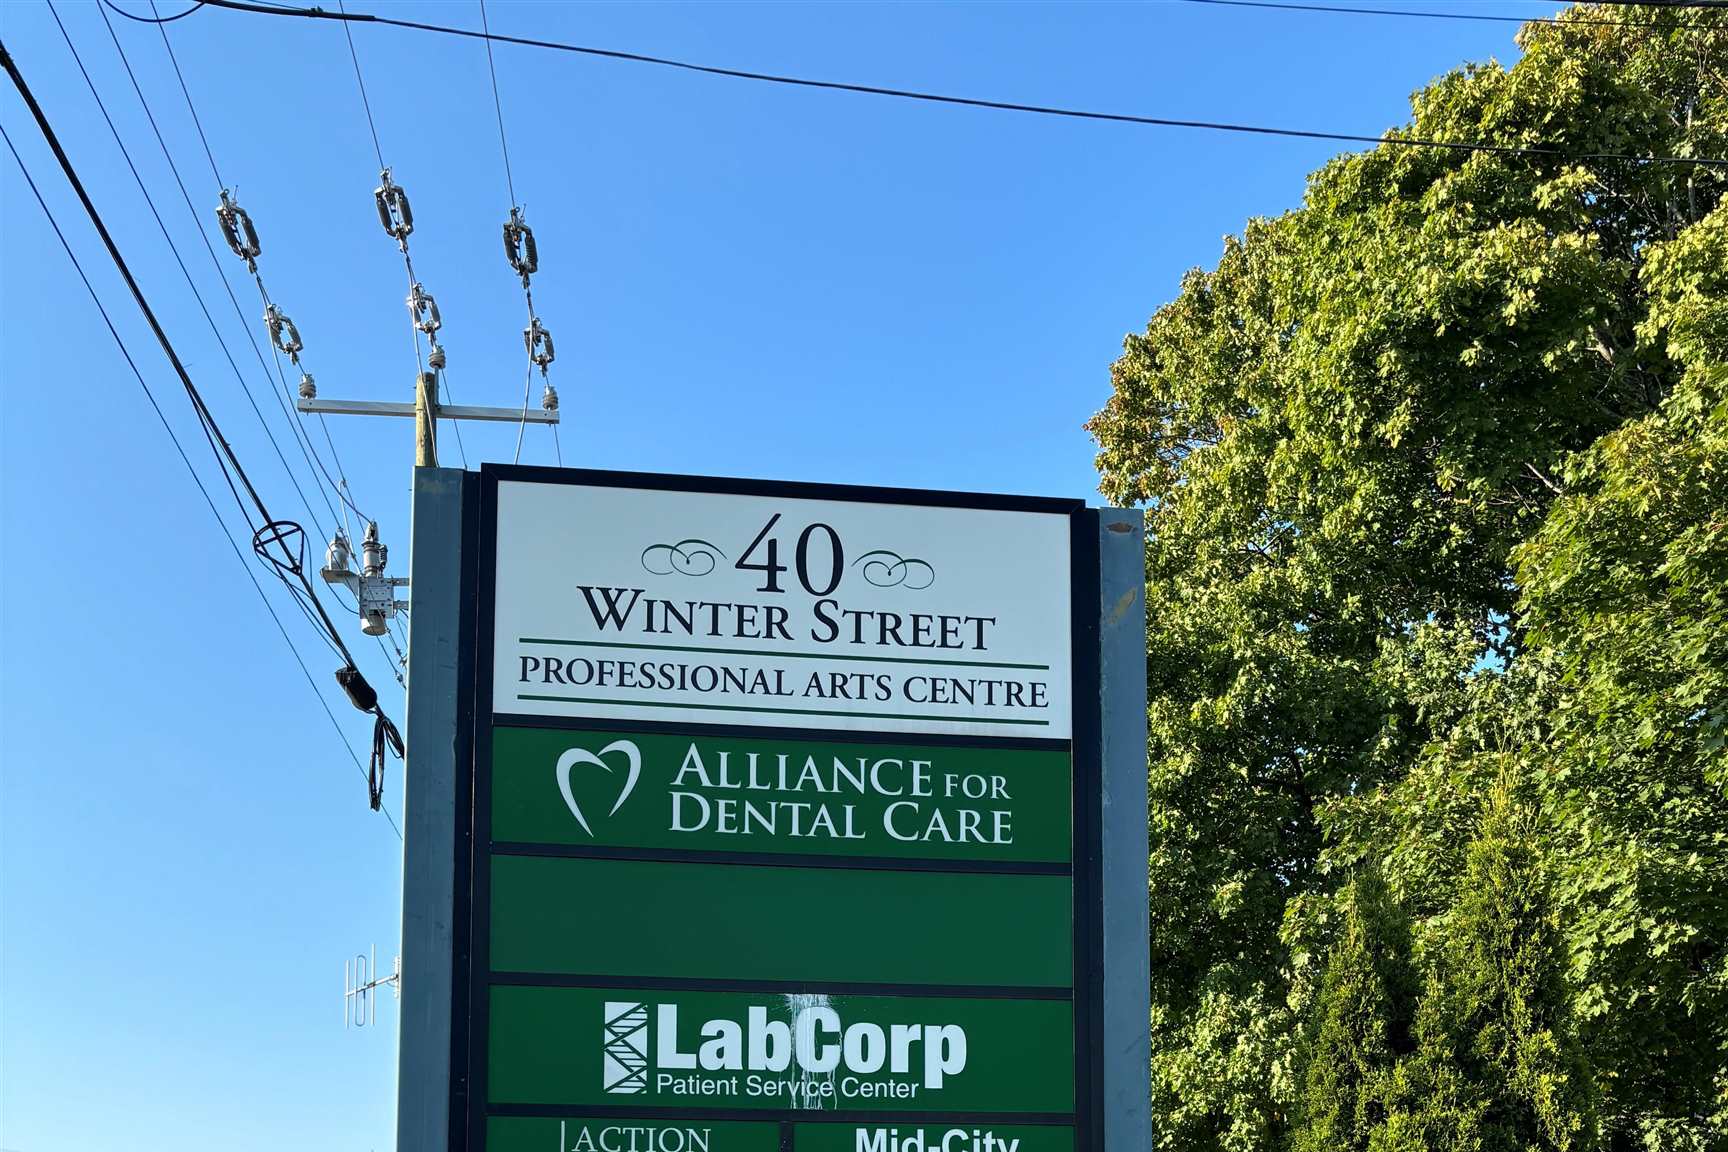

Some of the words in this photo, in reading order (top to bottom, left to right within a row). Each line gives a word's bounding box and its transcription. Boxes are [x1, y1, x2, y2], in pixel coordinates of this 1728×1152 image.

[735, 513, 844, 597] 40
[577, 585, 795, 641] WINTER
[811, 598, 996, 651] STREET
[518, 655, 795, 698] PROFESSIONAL
[802, 671, 892, 702] ARTS
[903, 676, 1050, 708] CENTRE
[669, 742, 933, 797] ALLIANCE
[944, 773, 1013, 800] FOR
[668, 791, 866, 839] DENTAL
[883, 801, 1013, 844] CARE
[656, 1003, 967, 1089] LabCorp
[657, 1073, 739, 1096] Patient
[745, 1075, 837, 1098] Service
[841, 1076, 920, 1099] Center
